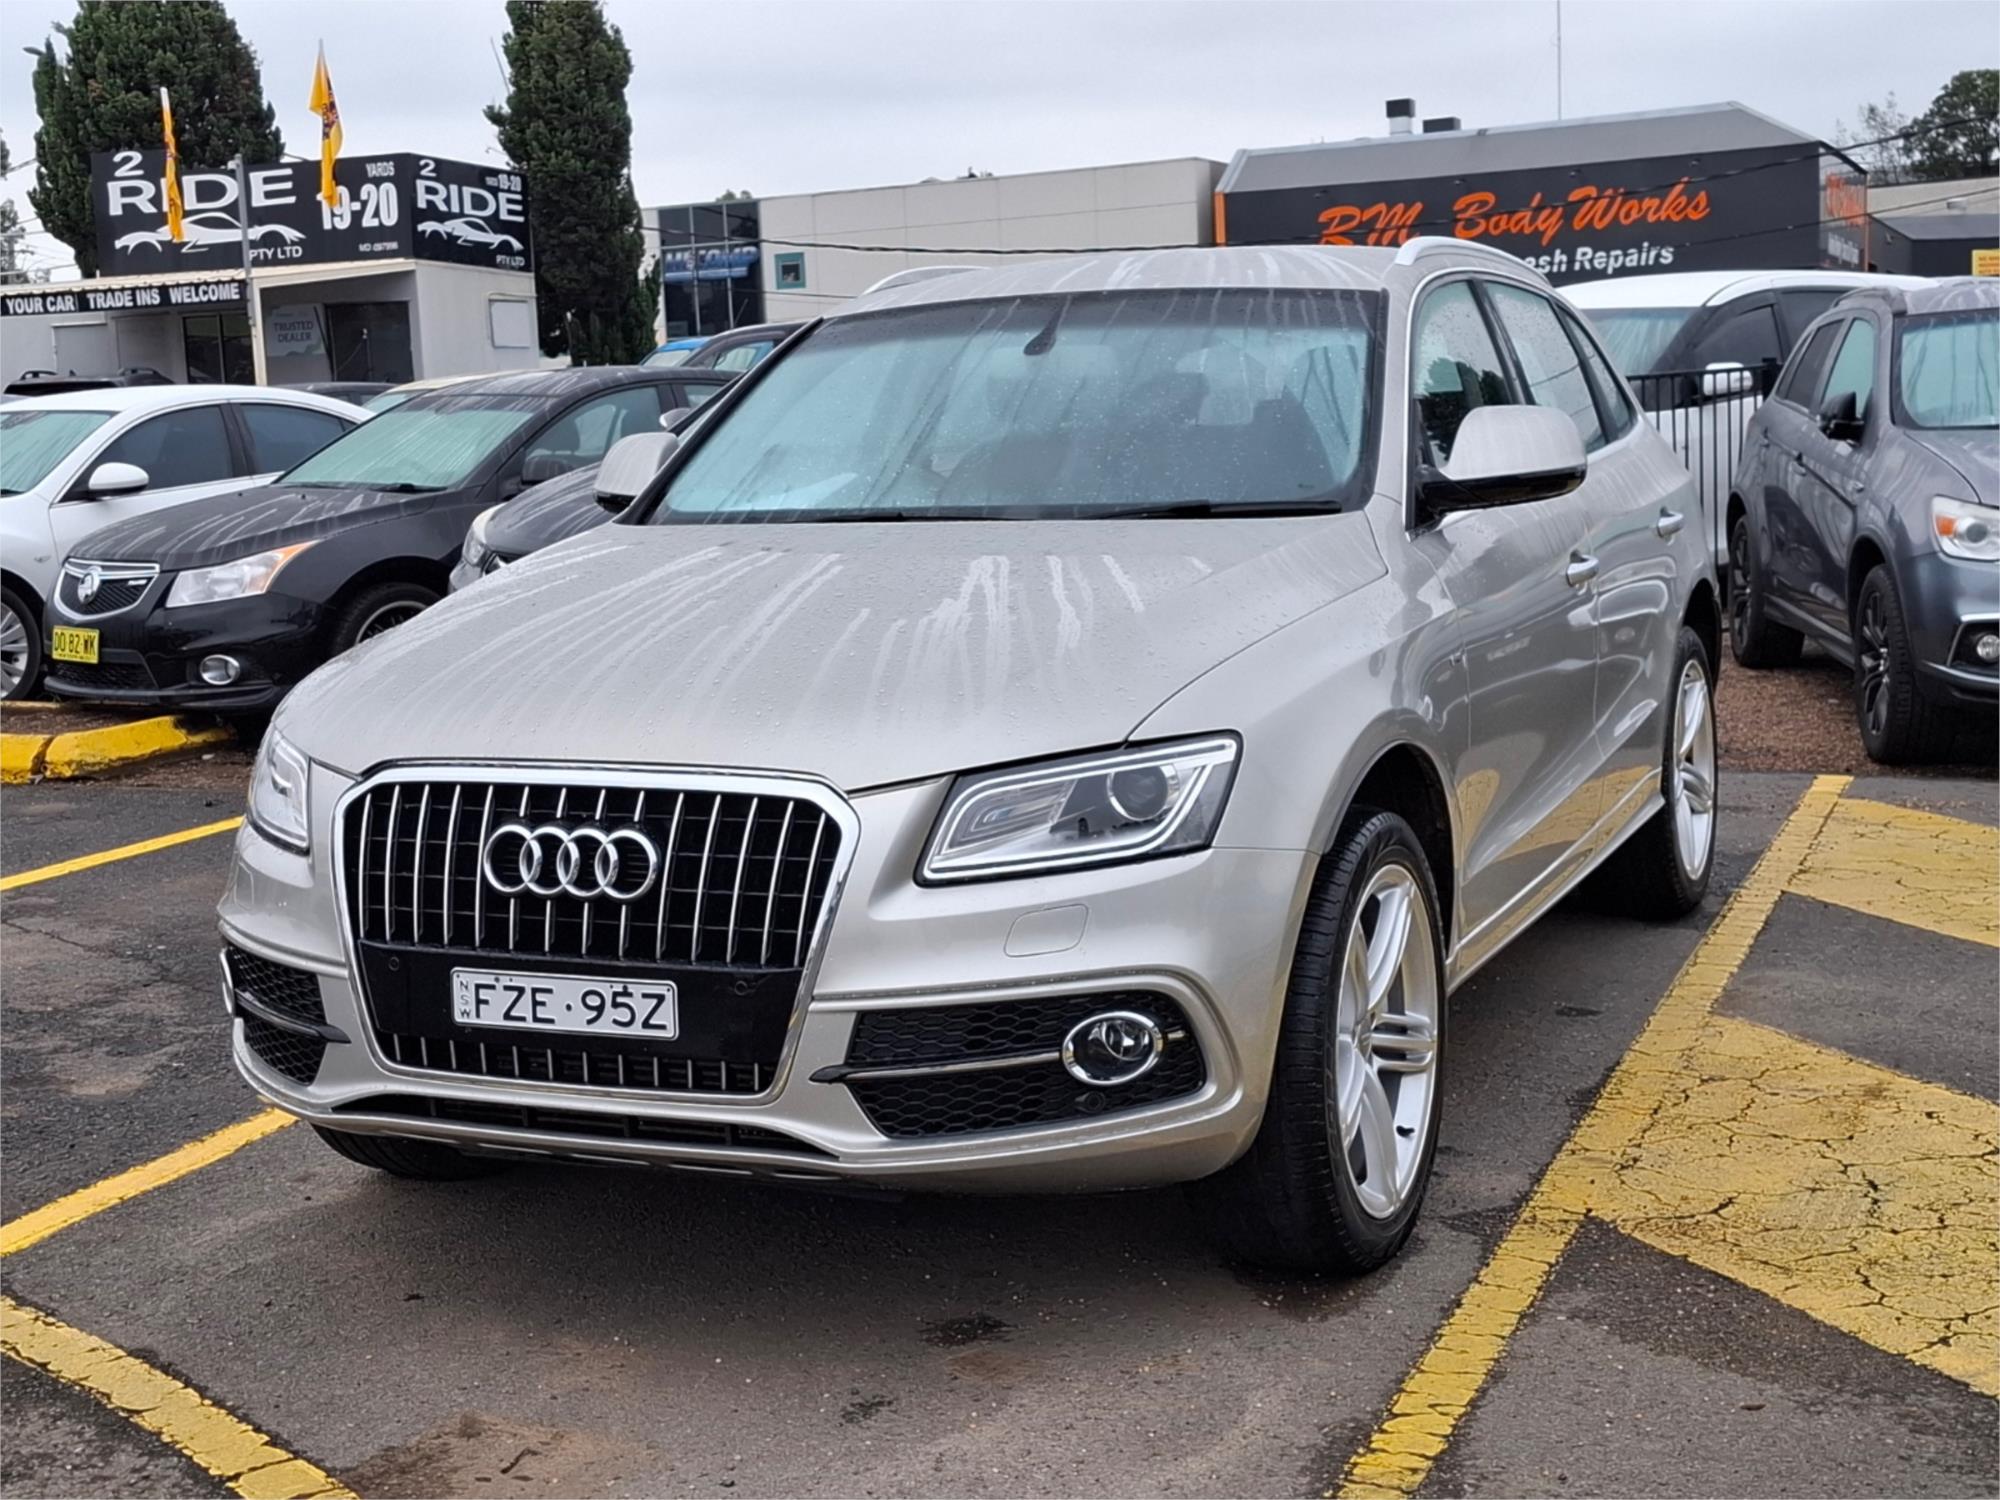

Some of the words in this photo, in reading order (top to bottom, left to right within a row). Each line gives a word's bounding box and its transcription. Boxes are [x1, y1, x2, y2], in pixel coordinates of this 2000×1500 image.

[113, 151, 144, 177] 2
[366, 162, 394, 178] YARDS
[419, 159, 437, 177] 2
[107, 168, 297, 216] RIDE
[316, 182, 399, 230] 19-20
[416, 179, 525, 223] RIDE
[1317, 201, 1424, 245] RM
[1453, 191, 1564, 246] Body
[1568, 177, 1711, 232] Works
[250, 250, 274, 261] PTY
[277, 246, 303, 259] LTD
[1574, 242, 1674, 275] Repairs
[6, 297, 43, 314] YOUR
[46, 295, 75, 312] CAR
[87, 290, 134, 309] TRADE
[137, 288, 160, 306] INS
[170, 283, 240, 304] WELCOME
[273, 320, 314, 332] TRUSTED
[277, 331, 312, 343] DEALER
